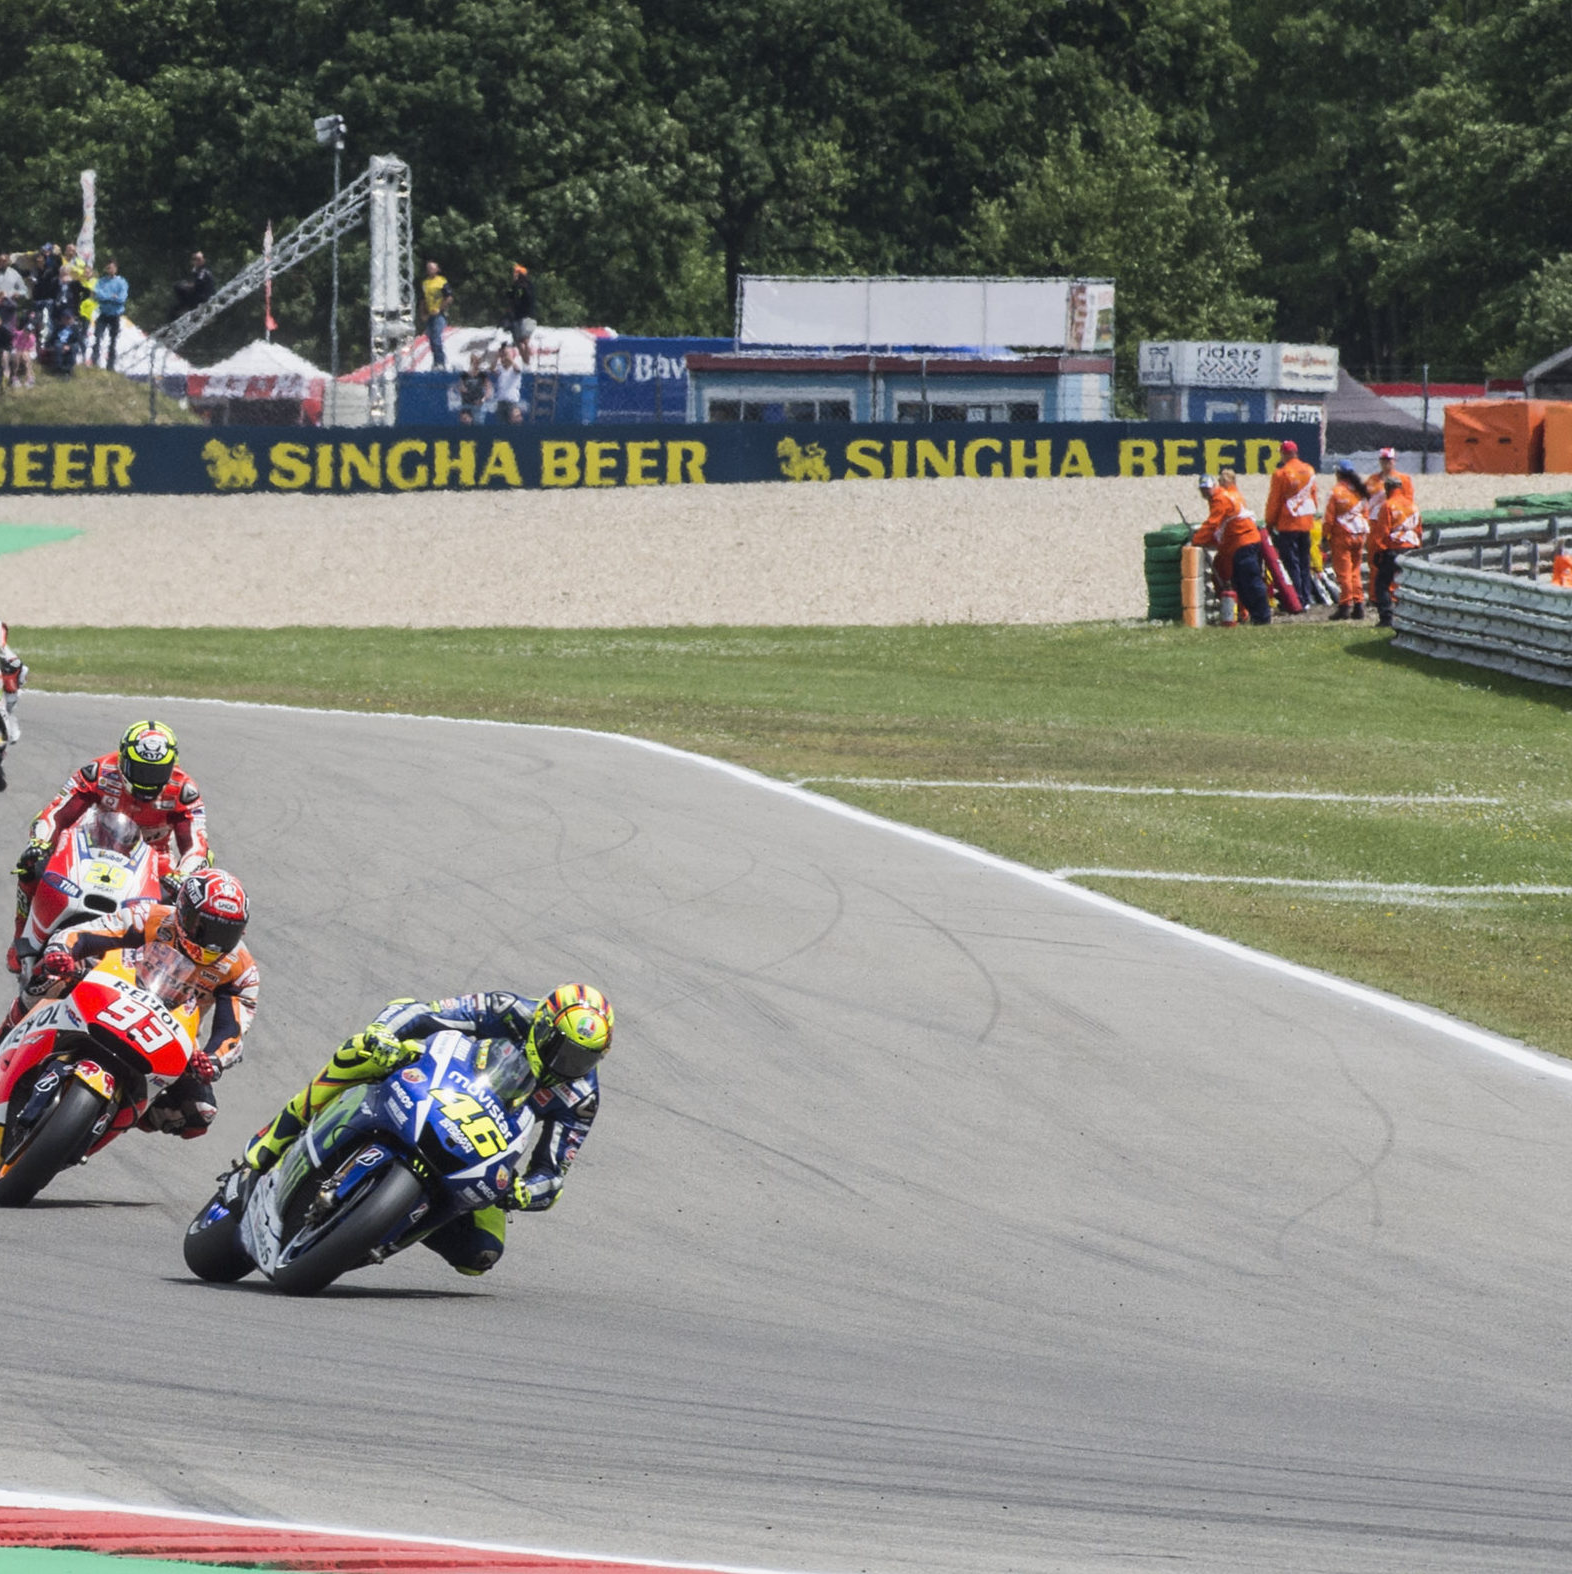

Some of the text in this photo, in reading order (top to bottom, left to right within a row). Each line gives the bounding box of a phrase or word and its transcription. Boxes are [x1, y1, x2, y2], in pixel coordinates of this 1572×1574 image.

[1197, 345, 1261, 359] riders
[269, 440, 707, 490] SINGHA BEER
[845, 438, 1282, 480] SINGHA BEER
[59, 880, 79, 896] TIM
[83, 862, 128, 890] 29
[95, 996, 175, 1053] 93
[390, 1081, 414, 1109] ENEOS
[448, 1070, 513, 1140] movistar
[428, 1087, 509, 1158] 46
